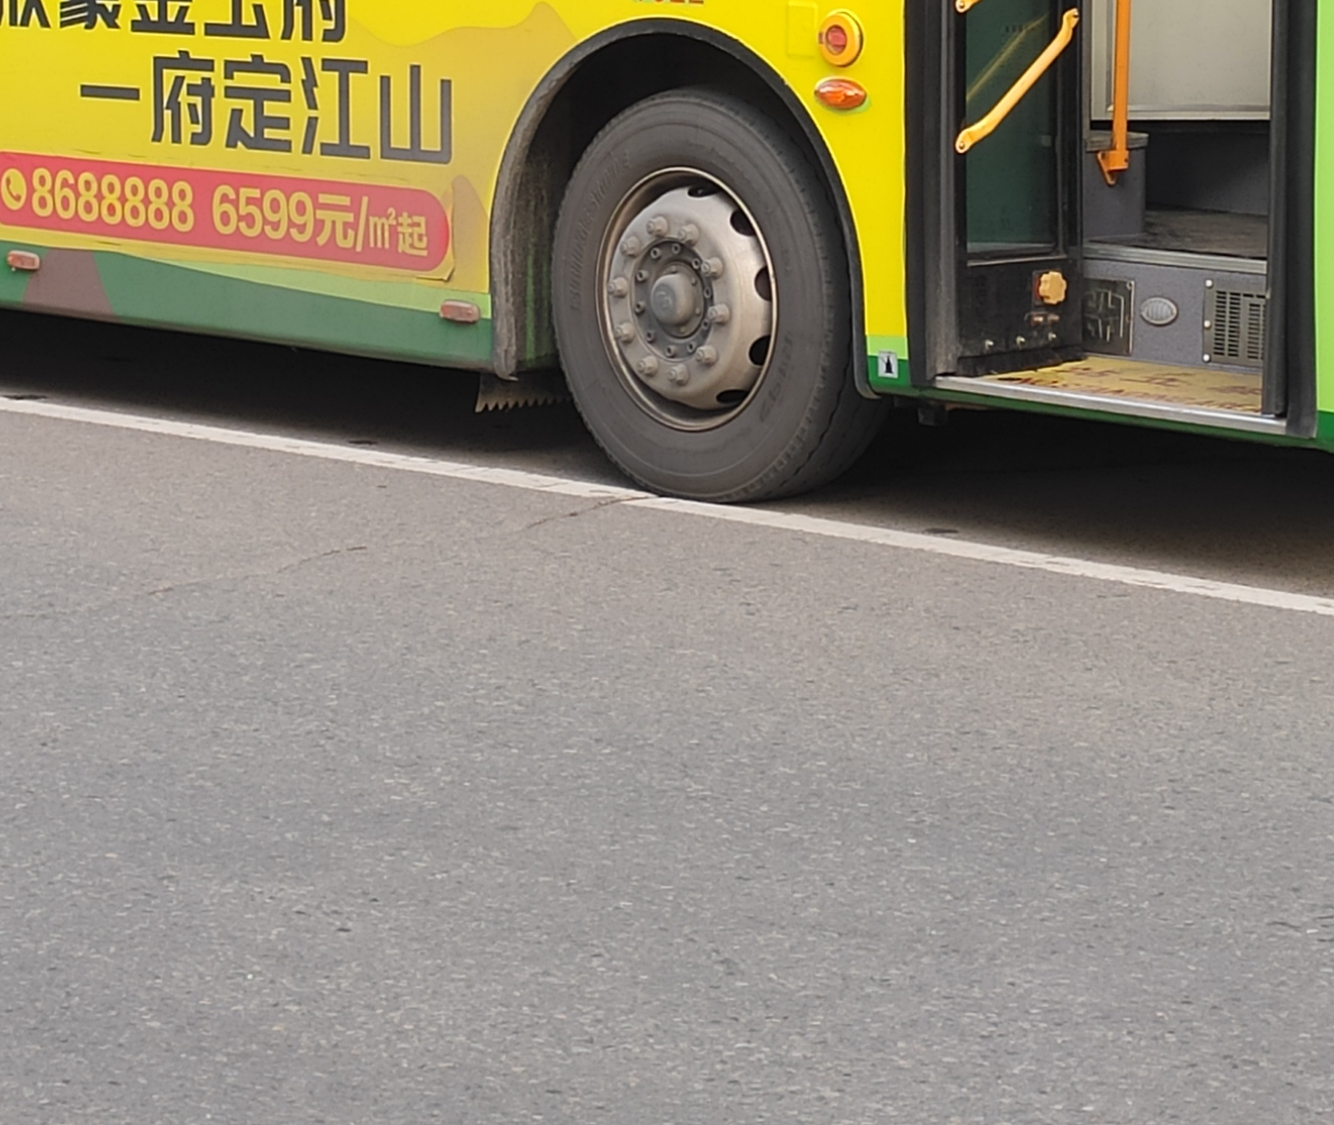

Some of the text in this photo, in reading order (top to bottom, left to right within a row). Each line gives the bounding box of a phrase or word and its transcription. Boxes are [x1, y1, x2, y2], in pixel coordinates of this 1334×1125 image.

[80, 50, 453, 165] 一府定江山
[31, 168, 194, 233] 8688888
